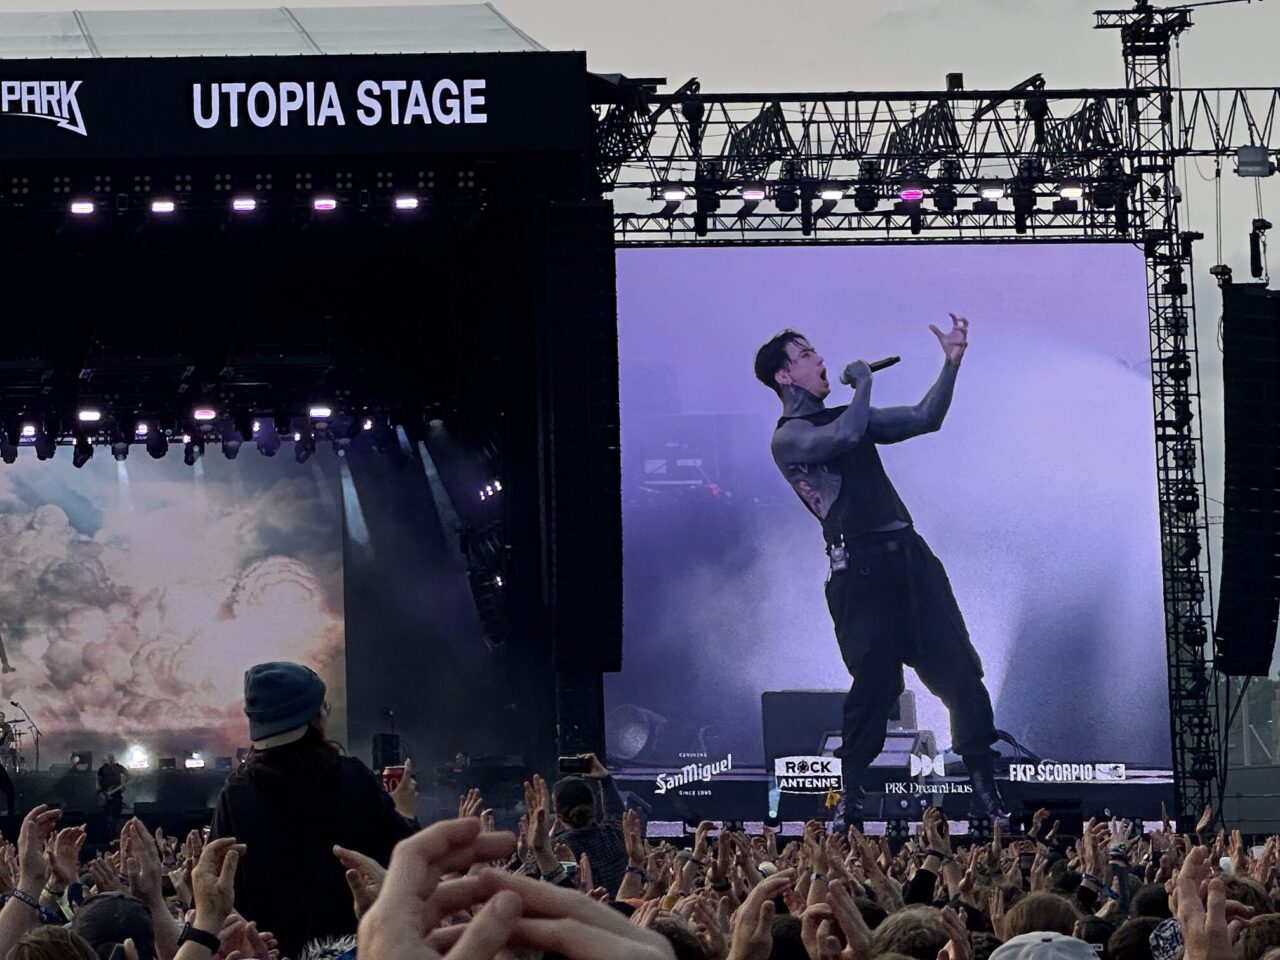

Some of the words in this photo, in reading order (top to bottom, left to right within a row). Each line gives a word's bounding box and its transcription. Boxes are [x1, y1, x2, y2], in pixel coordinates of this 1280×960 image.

[0, 80, 89, 137] PARK
[192, 81, 346, 129] UTOPIA
[356, 78, 488, 127] STAGE
[785, 759, 832, 774] ROCK
[1009, 763, 1035, 781] FKP
[1036, 763, 1094, 781] SCORPIO
[779, 777, 839, 788] ANTENNE
[884, 782, 908, 794] PRK
